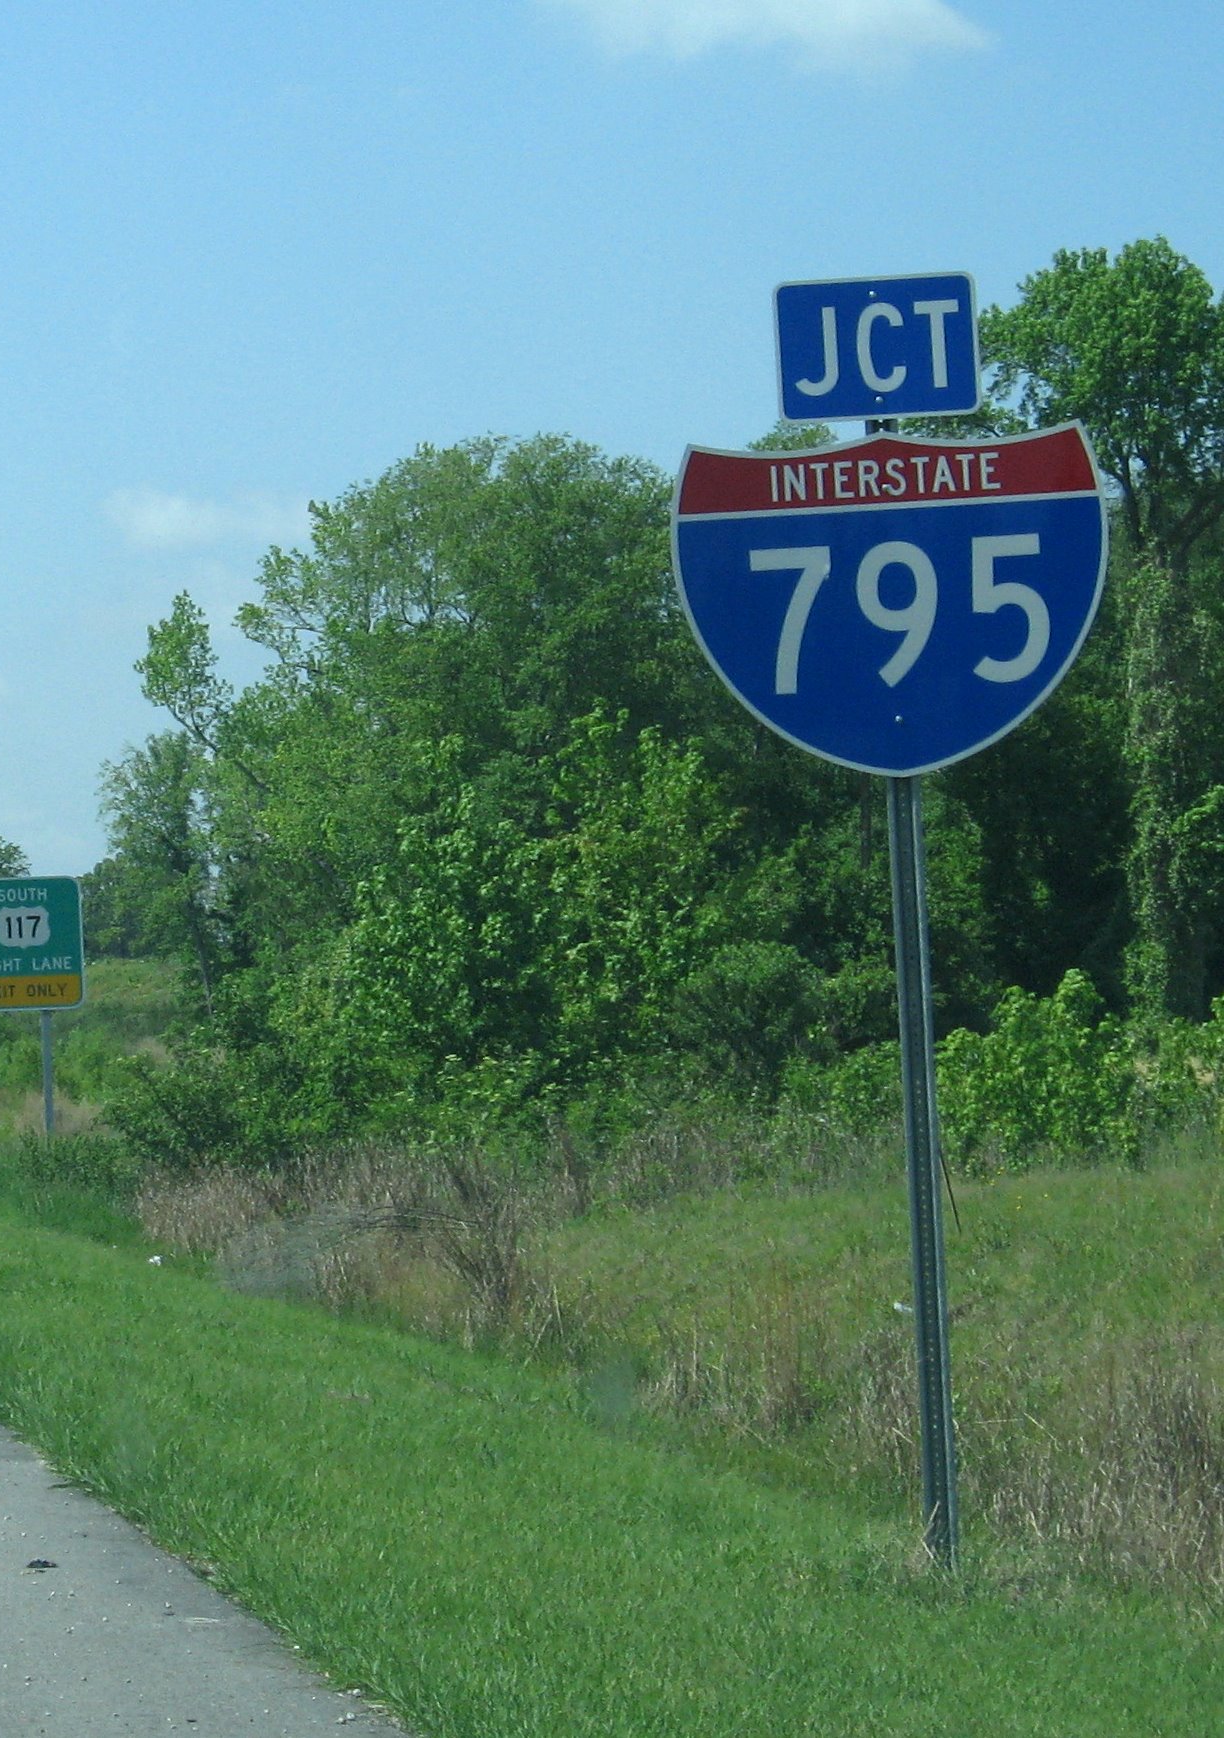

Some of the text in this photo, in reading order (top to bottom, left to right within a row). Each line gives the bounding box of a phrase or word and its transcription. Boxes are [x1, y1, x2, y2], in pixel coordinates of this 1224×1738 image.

[795, 299, 959, 397] JCT
[769, 451, 1001, 503] INTERSTATE
[749, 533, 1051, 696] 795
[5, 915, 41, 939] 117
[32, 956, 73, 971] LANE
[26, 982, 68, 997] ONLY
